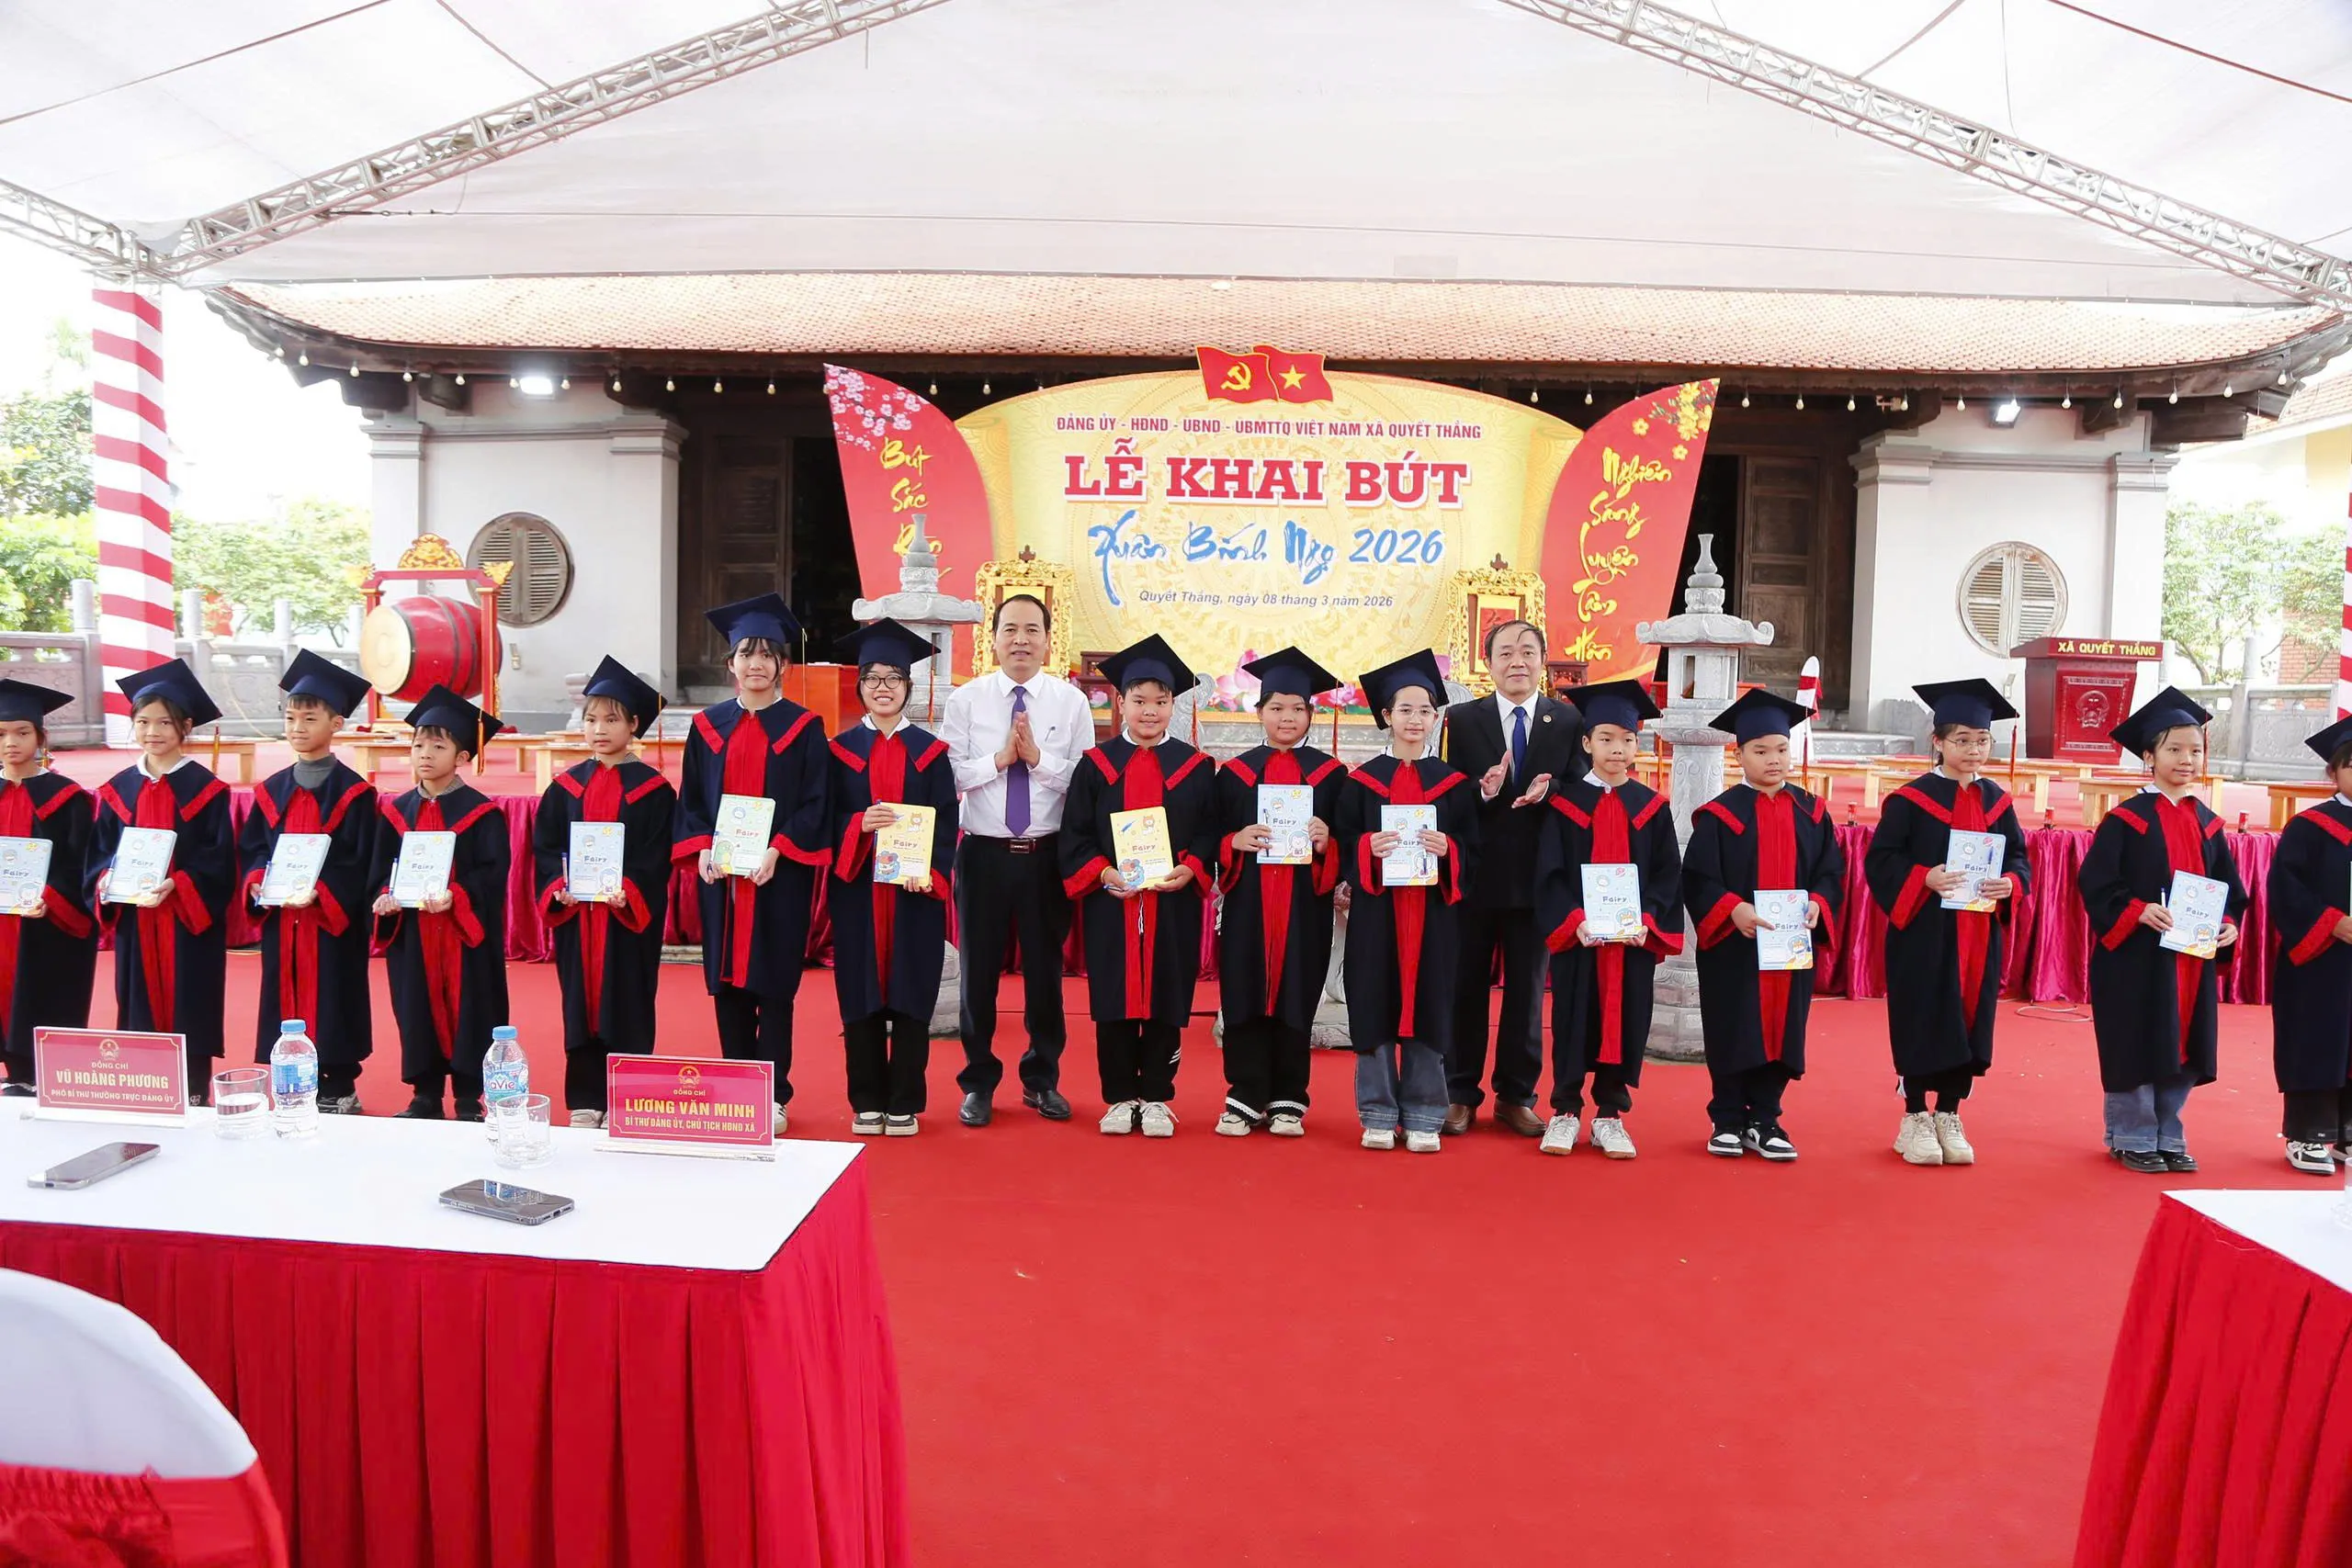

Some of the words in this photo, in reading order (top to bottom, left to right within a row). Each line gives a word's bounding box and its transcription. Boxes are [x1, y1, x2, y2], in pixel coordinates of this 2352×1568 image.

[1057, 412, 1095, 431] ĐẢNG
[1099, 412, 1117, 431] ỦY
[1131, 418, 1169, 432] HĐND
[1182, 419, 1221, 433] UBND
[1235, 419, 1291, 435] UBMTTQ
[1295, 419, 1325, 438] VIỆT
[1329, 422, 1362, 436] NAM
[1365, 420, 1384, 437] XÃ
[1388, 419, 1431, 438] QUYẾT
[1435, 420, 1481, 439] THẮNG
[879, 436, 934, 477] Bút
[1064, 437, 1144, 497] LỄ
[1166, 457, 1324, 501] KHAI
[1344, 450, 1468, 503] BÚT
[1601, 446, 1672, 500] Nghiên
[1589, 491, 1652, 540] Sáng
[1088, 509, 1168, 606] Xuân
[1182, 521, 1268, 562] Bính
[1283, 520, 1335, 585] Ngọ
[1348, 528, 1444, 564] 2026
[1579, 522, 1639, 585] Luyện
[1139, 589, 1177, 604] Quyết
[1182, 590, 1223, 604] Thắng,
[1227, 592, 1260, 606] ngày
[1262, 593, 1278, 604] 08
[1281, 594, 1317, 607] tháng
[1321, 594, 1329, 606] 3
[1332, 594, 1360, 606] năm
[1363, 595, 1394, 607] 2026
[2058, 640, 2075, 653] XÃ
[2079, 639, 2115, 654] QUYẾT
[2119, 641, 2156, 656] THẮNG
[893, 840, 918, 848] Fairy
[583, 855, 608, 863] Fairy
[56, 1068, 72, 1084] VŨ
[74, 1069, 116, 1087] HOÀNG
[119, 1073, 169, 1089] PHƯƠNG
[51, 1089, 66, 1098] PHÓ
[67, 1089, 75, 1098] BÍ
[90, 1090, 120, 1100] THƯỜNG
[121, 1092, 141, 1102] TRỰC
[625, 1098, 675, 1114] LƯƠNG
[679, 1099, 710, 1116] VĂN
[714, 1102, 755, 1118] MINH
[625, 1115, 633, 1126] BÍ
[635, 1116, 650, 1127] THƯ
[650, 1116, 672, 1128] ĐẢNG
[686, 1118, 701, 1130] CHỦ
[703, 1121, 720, 1132] TỊCH
[722, 1122, 743, 1133] HĐND
[744, 1121, 755, 1133] XÃ
